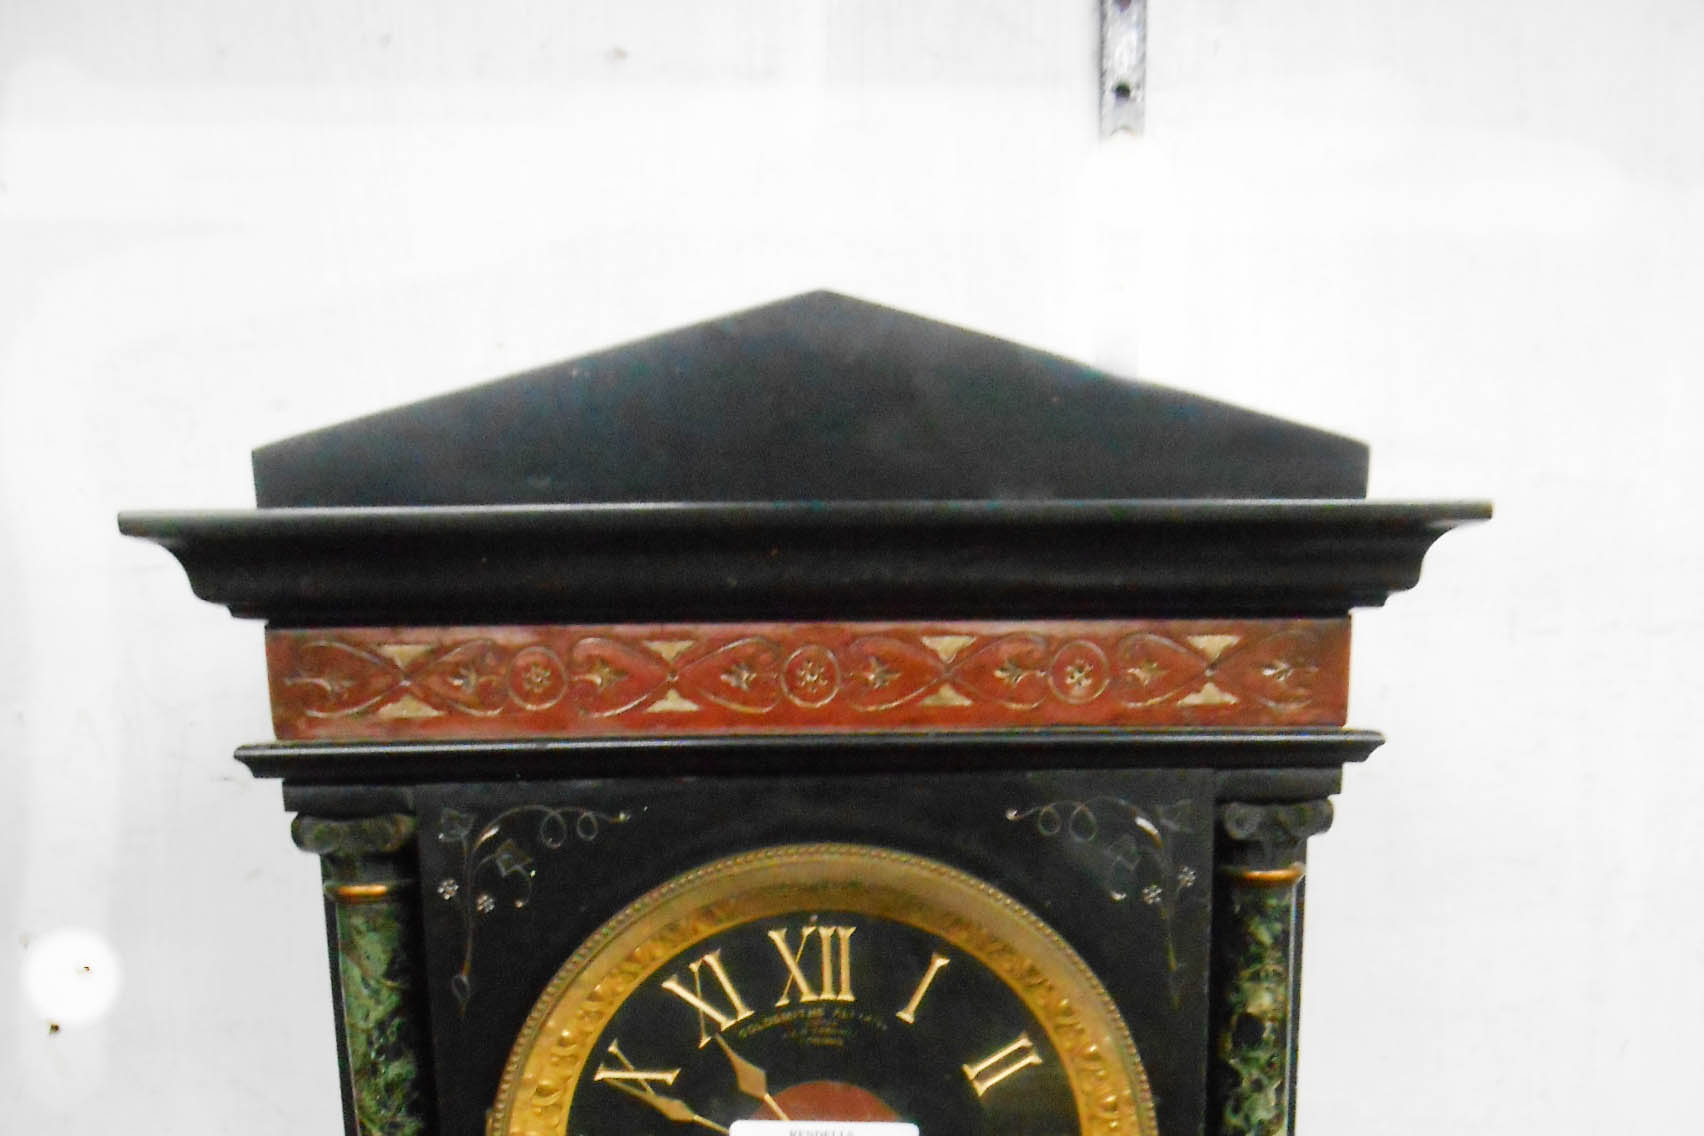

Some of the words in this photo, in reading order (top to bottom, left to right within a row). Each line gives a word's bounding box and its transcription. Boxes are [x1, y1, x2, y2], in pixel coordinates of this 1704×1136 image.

[662, 948, 754, 1048] XI
[768, 925, 856, 1005] XII
[897, 952, 950, 1024] I
[593, 1039, 681, 1097] X
[962, 1033, 1043, 1097] II
